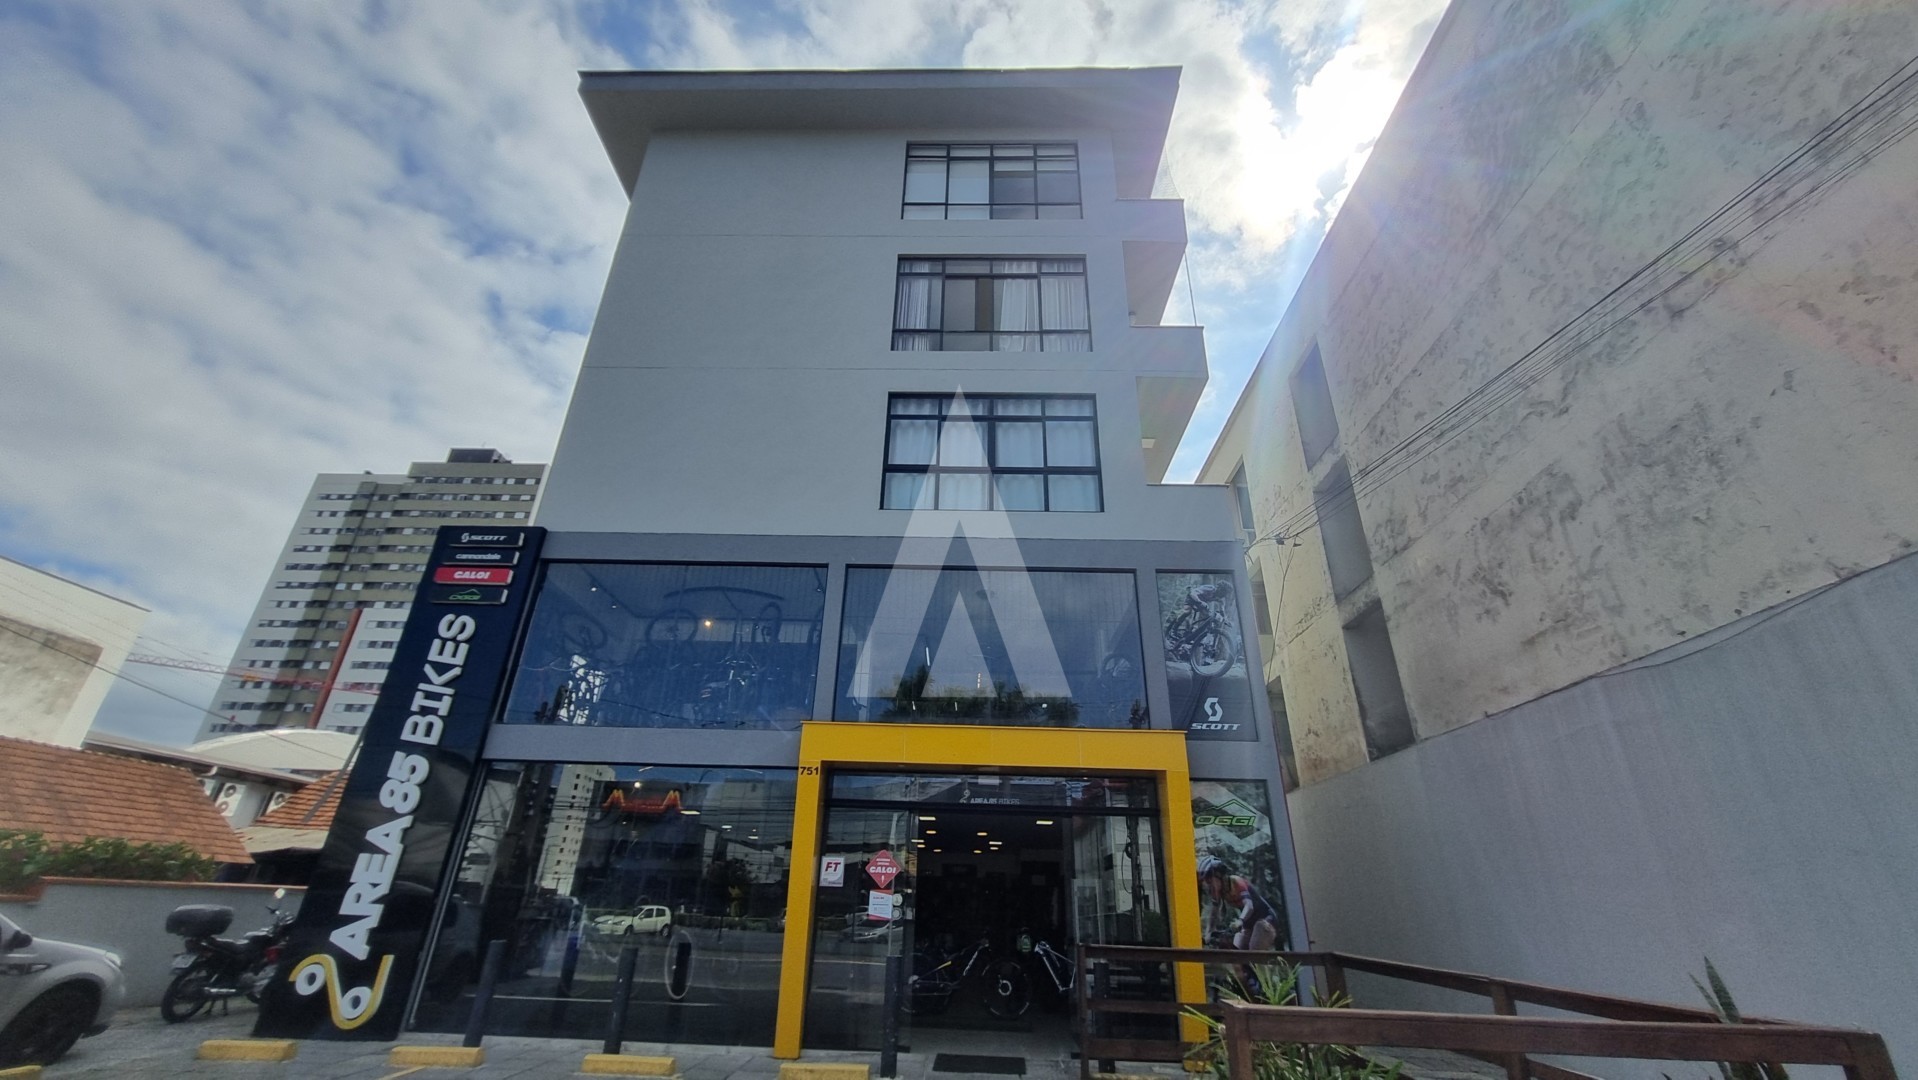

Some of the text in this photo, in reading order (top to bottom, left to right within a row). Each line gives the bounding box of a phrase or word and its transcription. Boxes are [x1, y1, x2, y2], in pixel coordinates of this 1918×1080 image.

[453, 571, 491, 579] CALOI
[1191, 722, 1240, 730] SCOTT
[800, 766, 819, 775] 751
[329, 613, 477, 960] AREA 85 BIKES
[1195, 815, 1256, 826] OGGI
[825, 862, 841, 872] FT
[869, 866, 897, 874] CALOI
